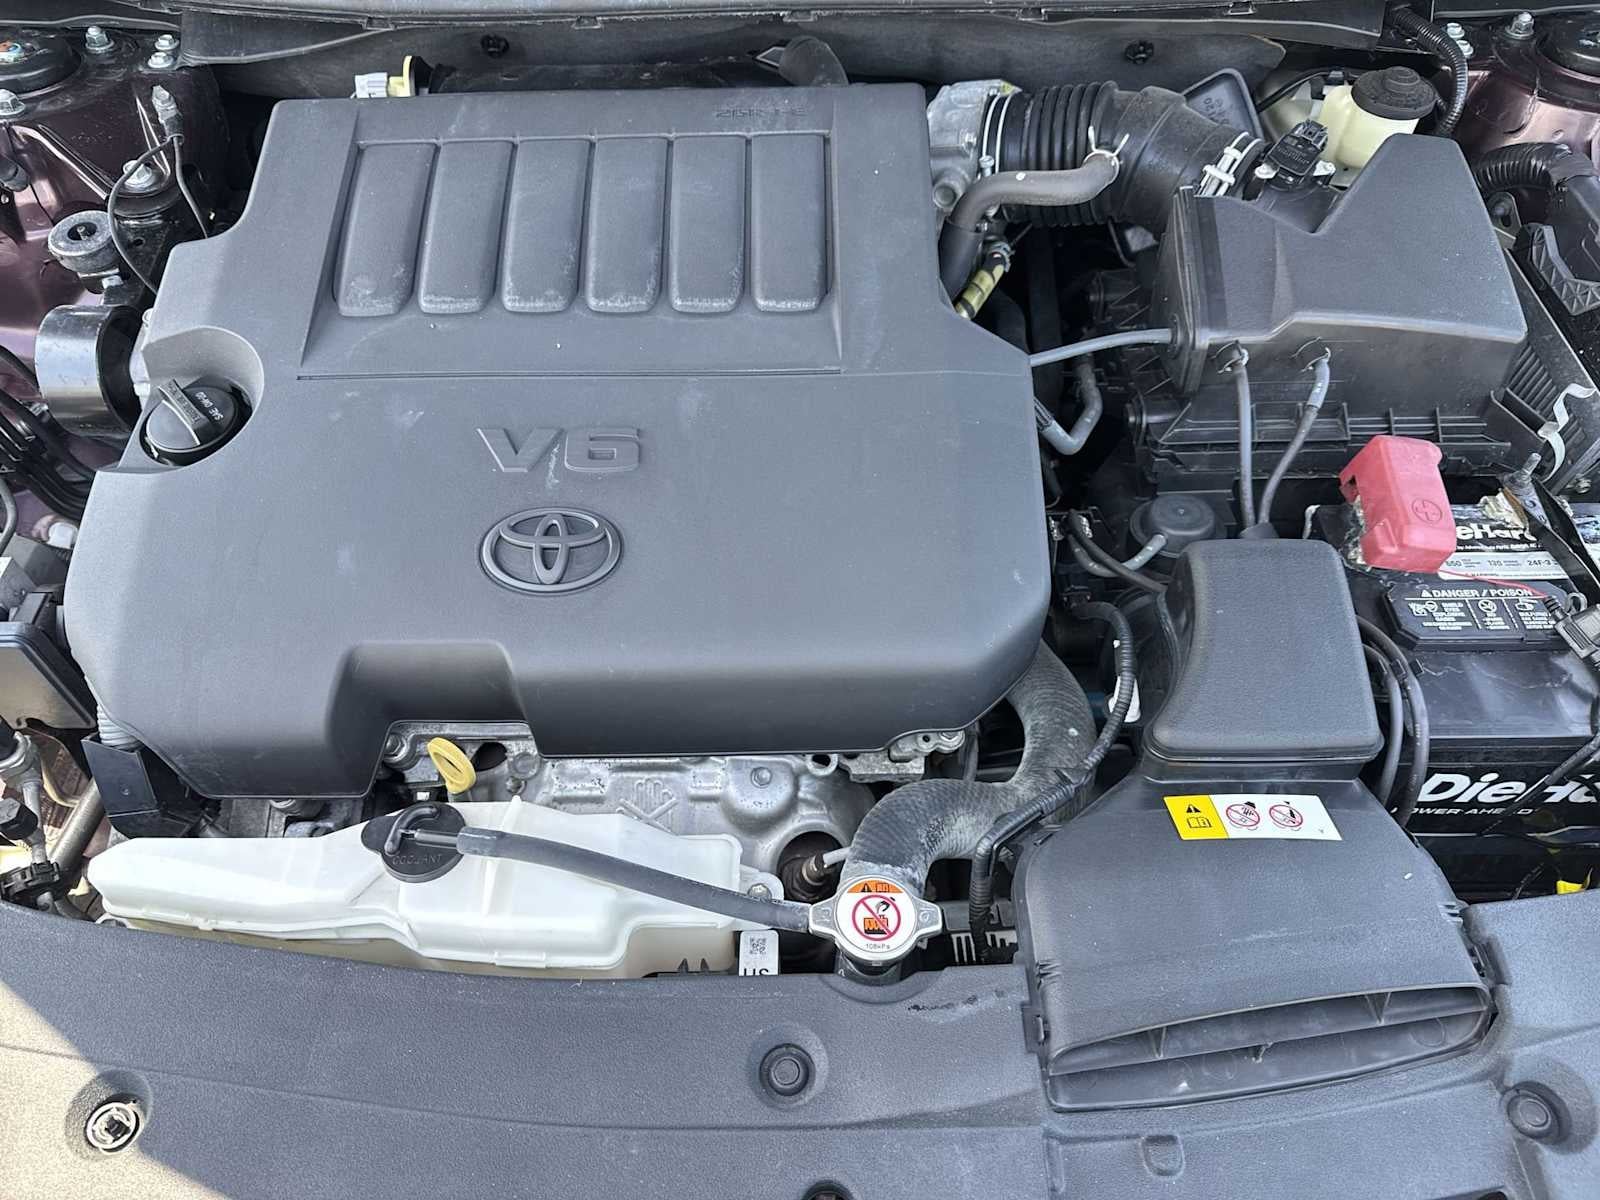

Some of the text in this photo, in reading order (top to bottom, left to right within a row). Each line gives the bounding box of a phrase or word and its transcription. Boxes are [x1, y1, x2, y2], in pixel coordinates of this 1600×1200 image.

[475, 427, 641, 473] V6
[1431, 588, 1533, 598] DANGER / POISON
[392, 853, 443, 866] COOLANT
